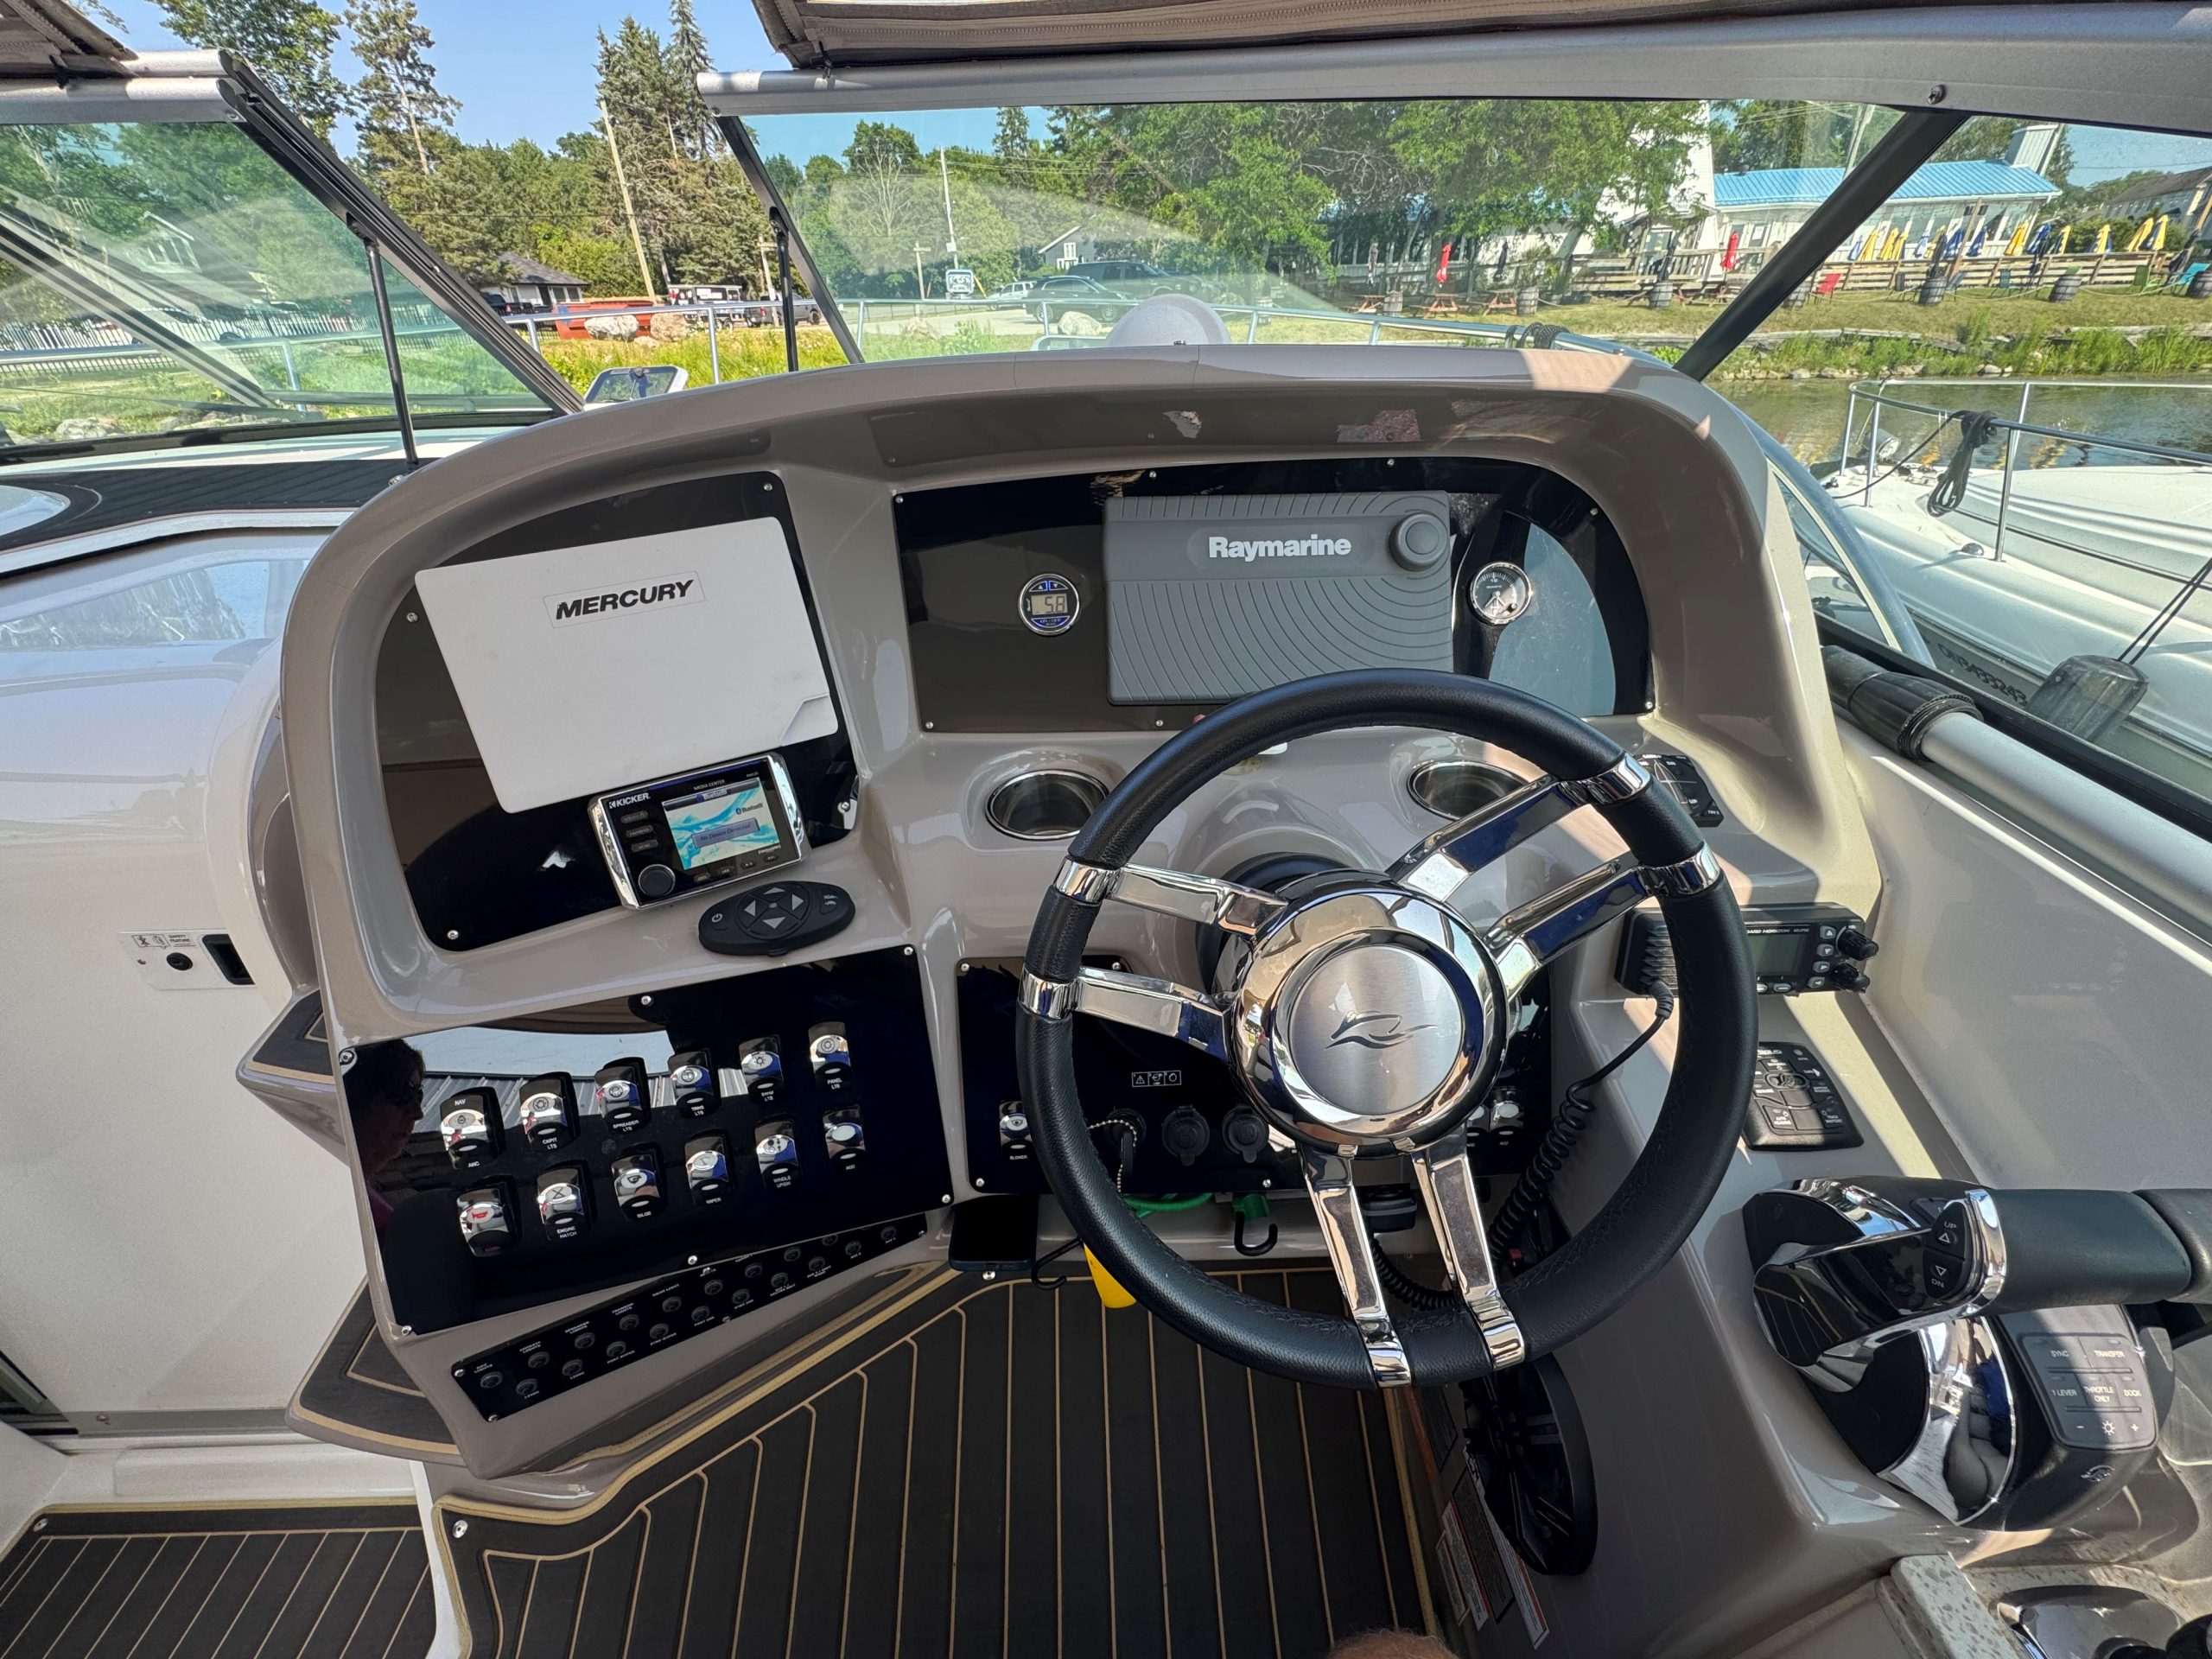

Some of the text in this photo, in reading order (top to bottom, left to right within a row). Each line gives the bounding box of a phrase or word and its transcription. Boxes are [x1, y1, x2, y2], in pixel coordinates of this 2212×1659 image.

[1209, 533, 1352, 563] Raymarine
[556, 579, 695, 620] MERCURY
[709, 779, 726, 787] CENTER
[702, 789, 728, 800] Bluetooth
[615, 792, 650, 808] KICKER
[454, 1098, 467, 1107] NAV
[613, 1119, 639, 1129] SPREADER
[542, 1136, 558, 1146] CKPIT
[556, 1225, 576, 1235] ENGINE
[559, 1230, 578, 1239] HATCH
[1931, 1279, 1944, 1287] DN
[2094, 1350, 2126, 1358] TRANSFER
